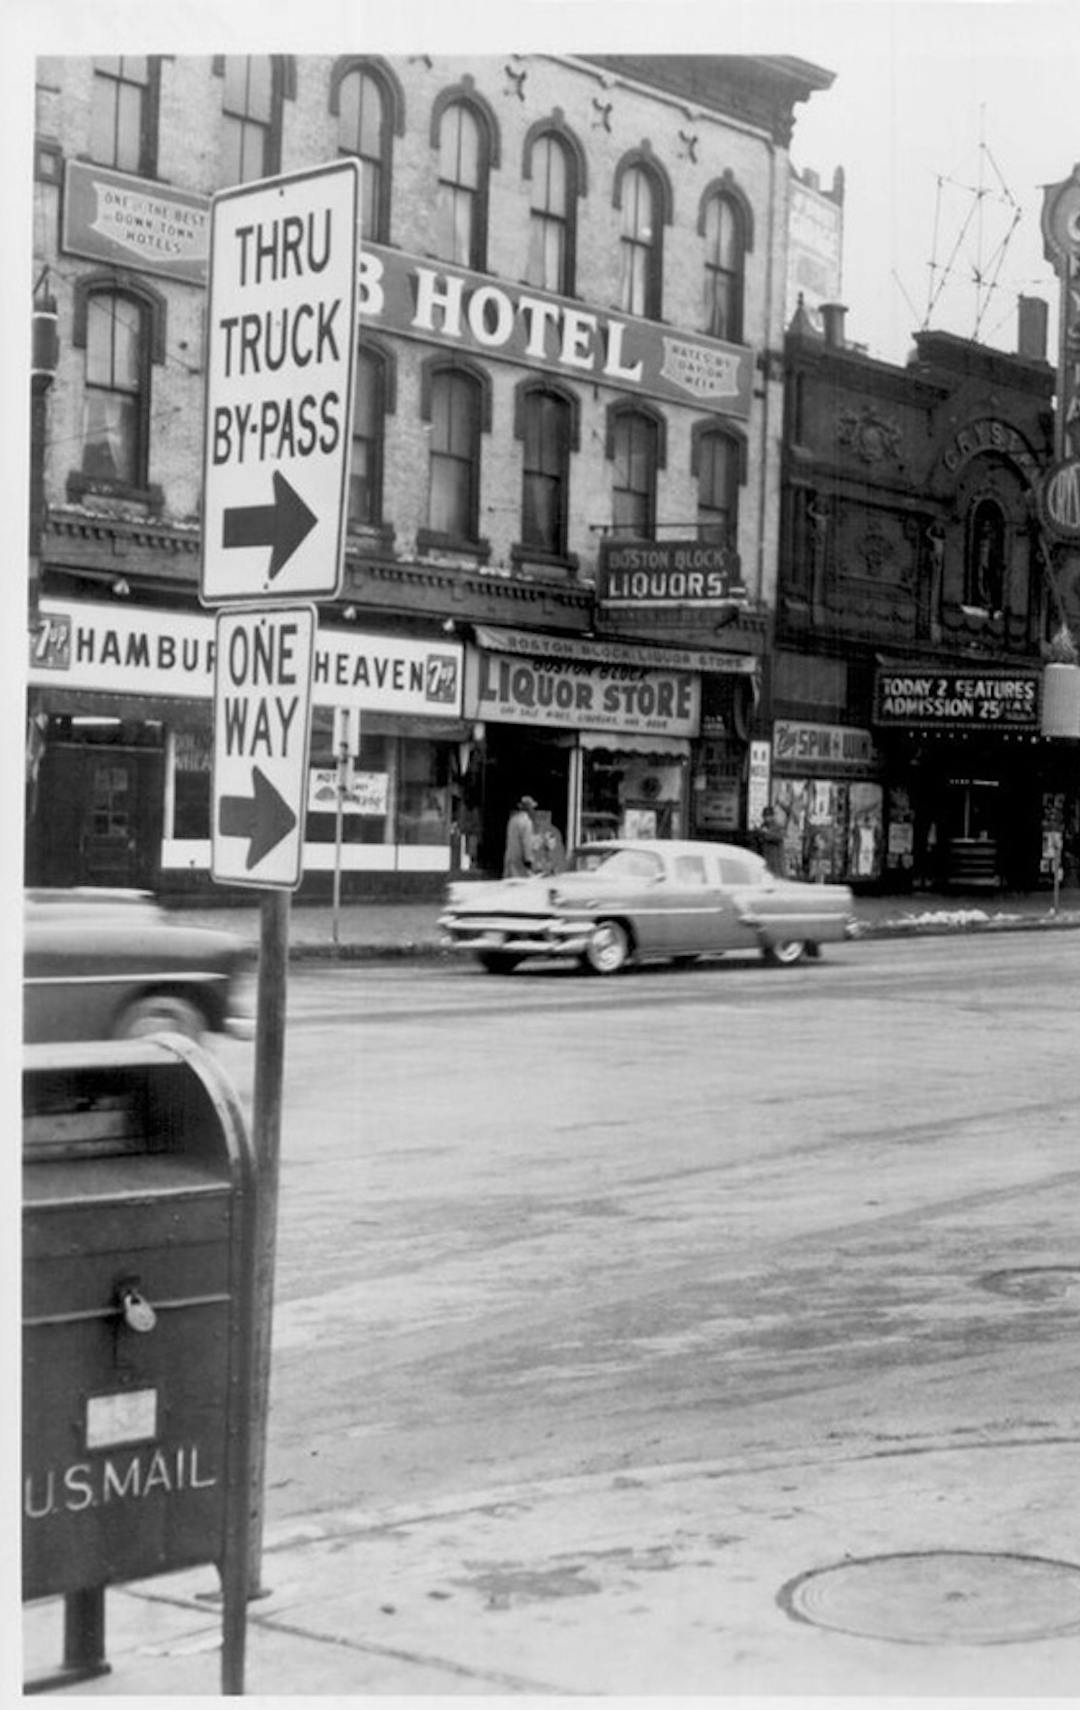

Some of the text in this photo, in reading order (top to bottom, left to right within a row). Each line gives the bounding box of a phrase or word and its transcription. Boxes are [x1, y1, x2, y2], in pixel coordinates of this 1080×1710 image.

[105, 192, 128, 208] ONE
[175, 209, 206, 227] BEST
[126, 230, 181, 254] HOTELS
[235, 208, 332, 286] THRU
[220, 299, 341, 376] TRUCK
[411, 266, 644, 382] HOTEL
[213, 391, 340, 466] BY-PASS
[608, 549, 725, 570] BOSTON BLOCK
[608, 572, 722, 598] LIQUORS
[229, 624, 298, 686] ONE
[314, 652, 423, 691] HEAVEN
[508, 636, 574, 654] BOSTON
[582, 644, 633, 661] BLOCK
[479, 653, 693, 720] LIQUOR STORE
[881, 697, 975, 717] ADMISSION
[882, 678, 1036, 700] TODAY 2 FEATURES
[224, 697, 299, 758] WAY
[103, 1445, 217, 1501] MAIL
